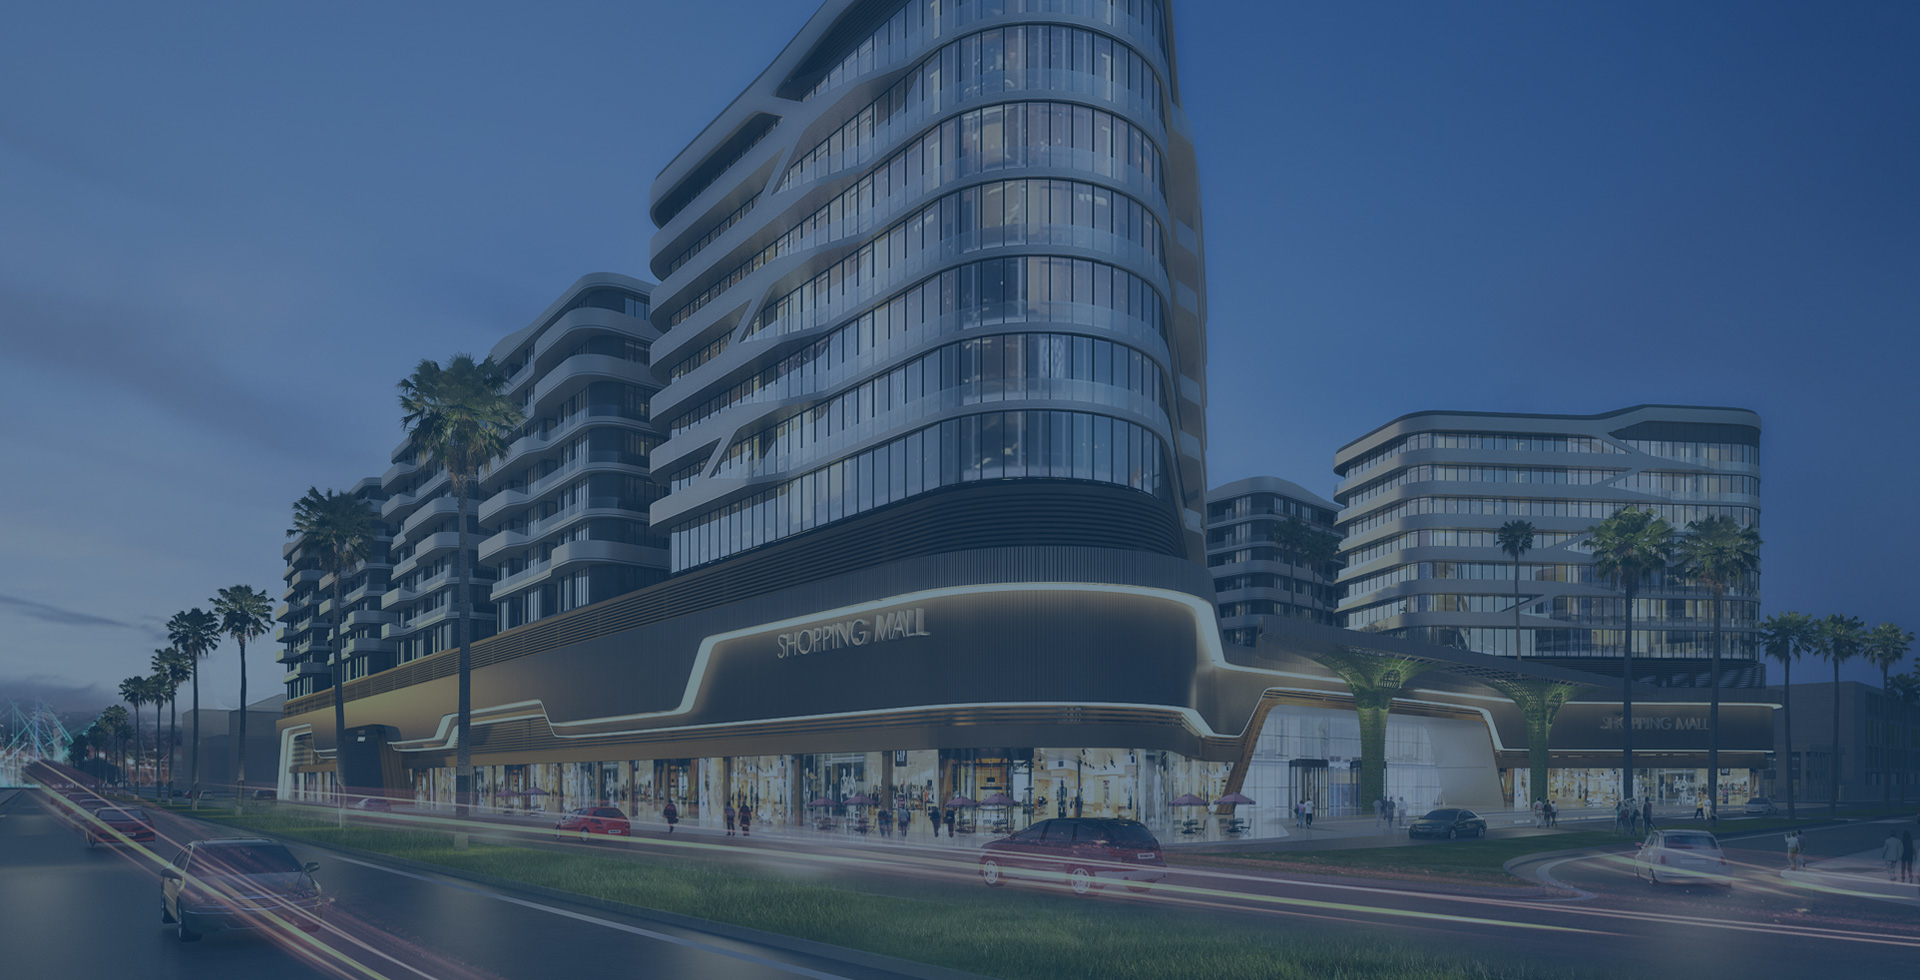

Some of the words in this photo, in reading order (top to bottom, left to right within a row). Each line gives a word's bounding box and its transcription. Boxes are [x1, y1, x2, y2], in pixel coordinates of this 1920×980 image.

[777, 619, 871, 659] SHOPPING
[874, 608, 930, 642] MALL
[1675, 716, 1710, 730] MALL
